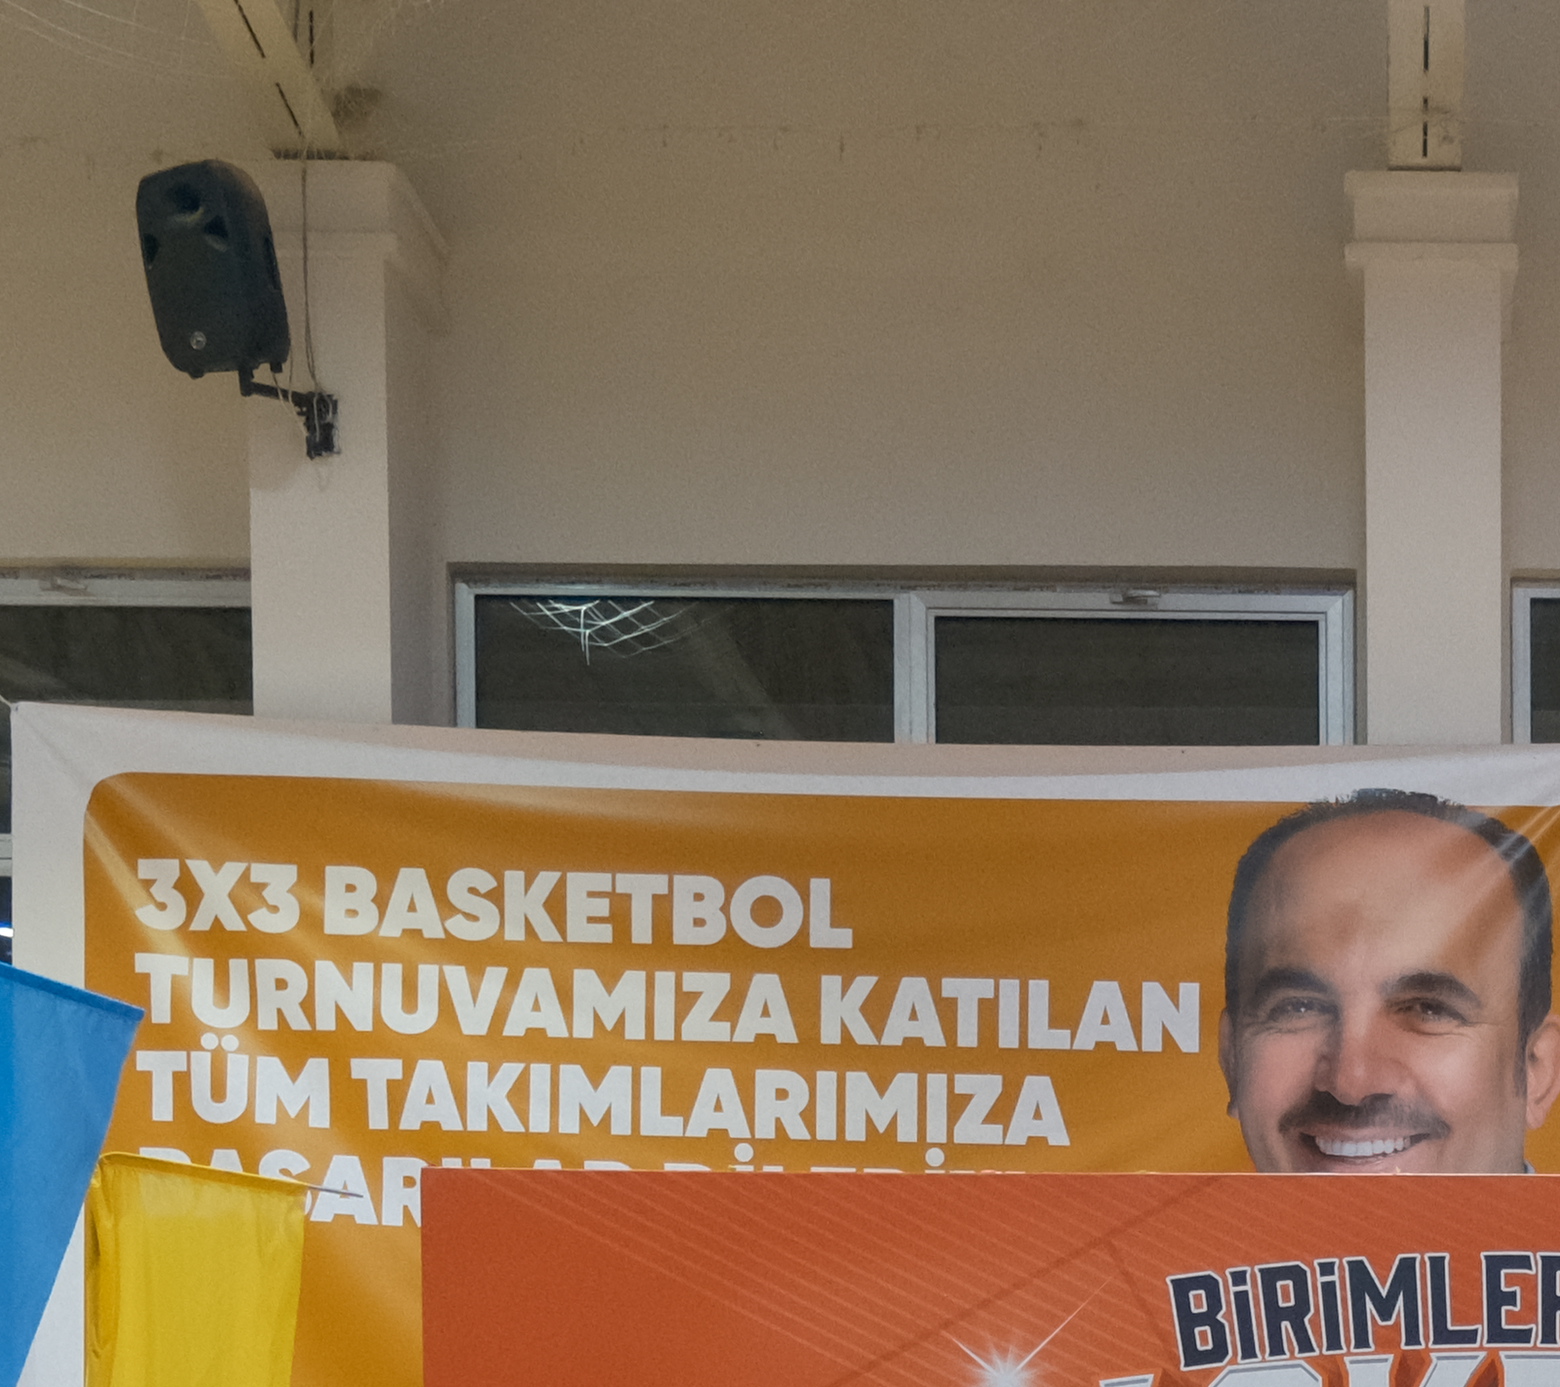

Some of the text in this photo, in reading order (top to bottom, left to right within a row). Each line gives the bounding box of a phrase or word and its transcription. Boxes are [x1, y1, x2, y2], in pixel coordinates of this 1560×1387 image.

[134, 858, 853, 949] 3X3 BASKETBOL
[134, 953, 1200, 1053] TURNUVAMIZA KATILAN
[136, 1032, 1070, 1147] TÜM TAKIMLARIMIZA
